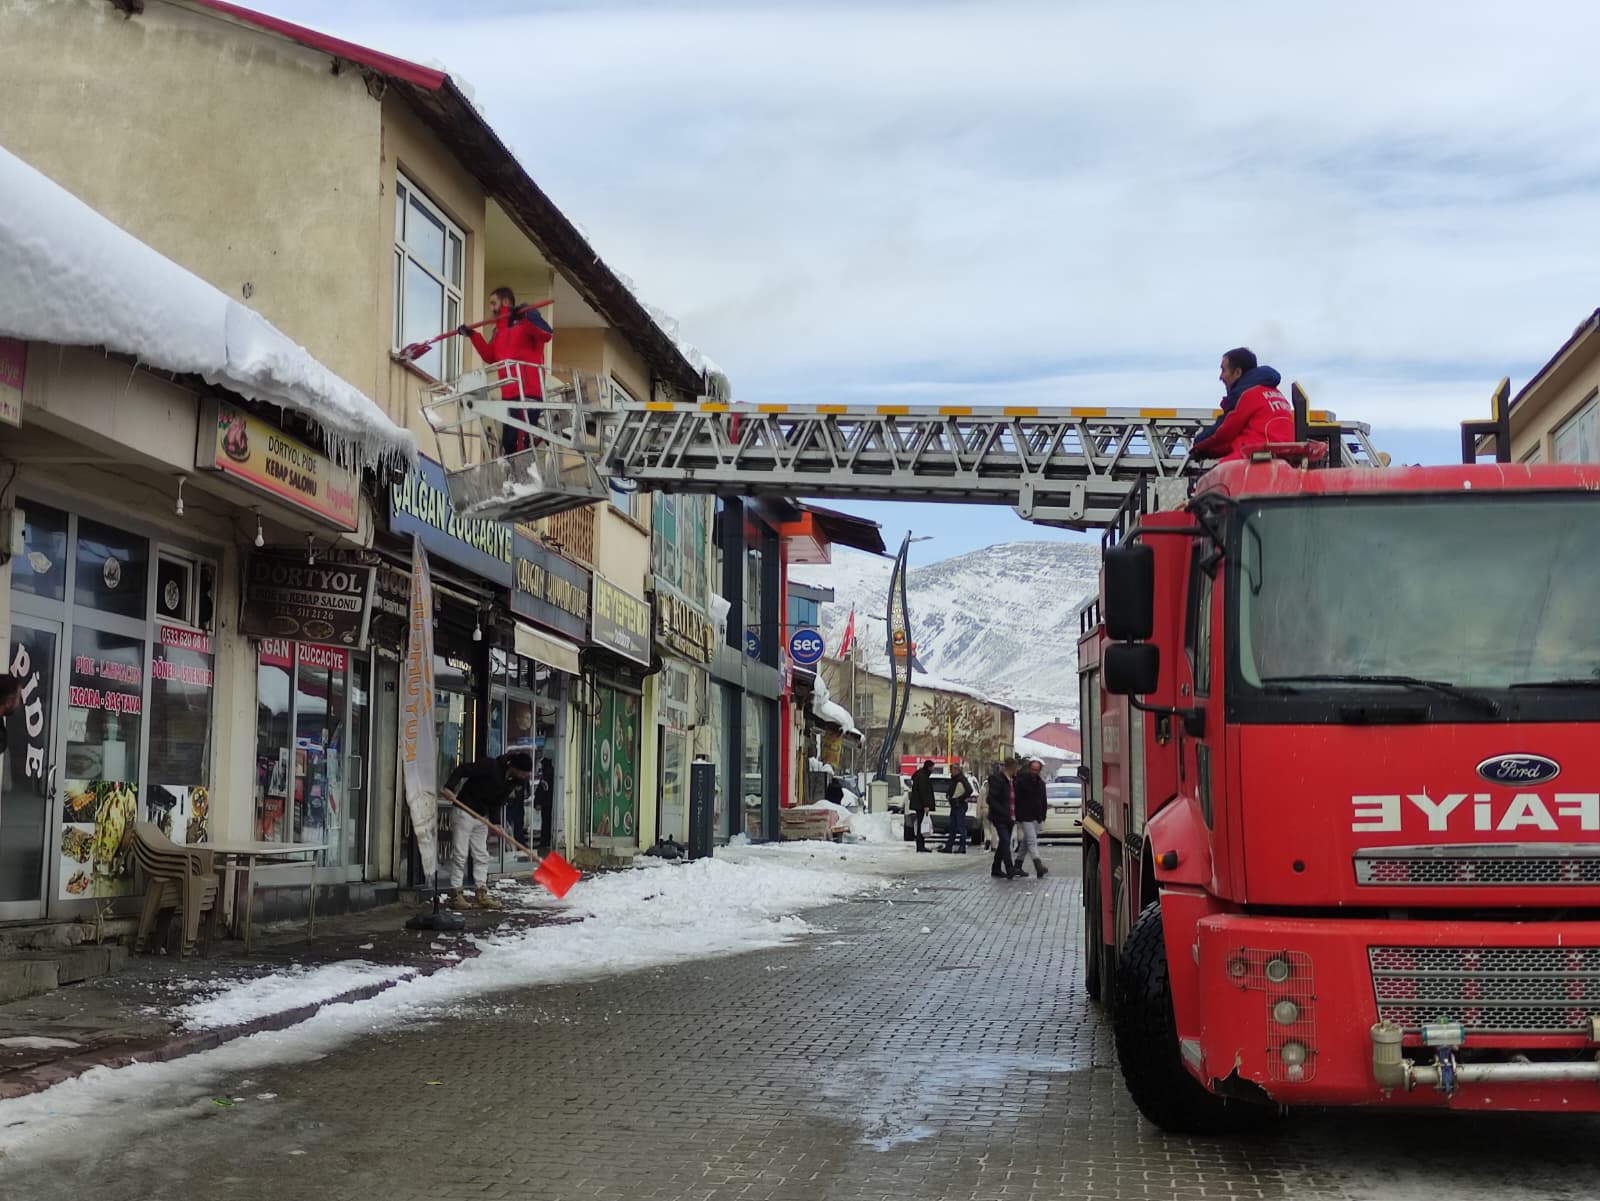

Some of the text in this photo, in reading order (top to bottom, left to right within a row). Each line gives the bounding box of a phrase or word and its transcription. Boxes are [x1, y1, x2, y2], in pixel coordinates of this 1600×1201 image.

[265, 456, 317, 496] KEBAP SALONU
[320, 595, 357, 610] SALONU
[322, 611, 334, 620] 26
[161, 627, 178, 645] 0533
[180, 631, 192, 647] 620
[152, 656, 176, 681] DÖNER
[10, 643, 45, 779] PİDE
[121, 695, 141, 715] TAVA
[1497, 759, 1541, 778] Ford
